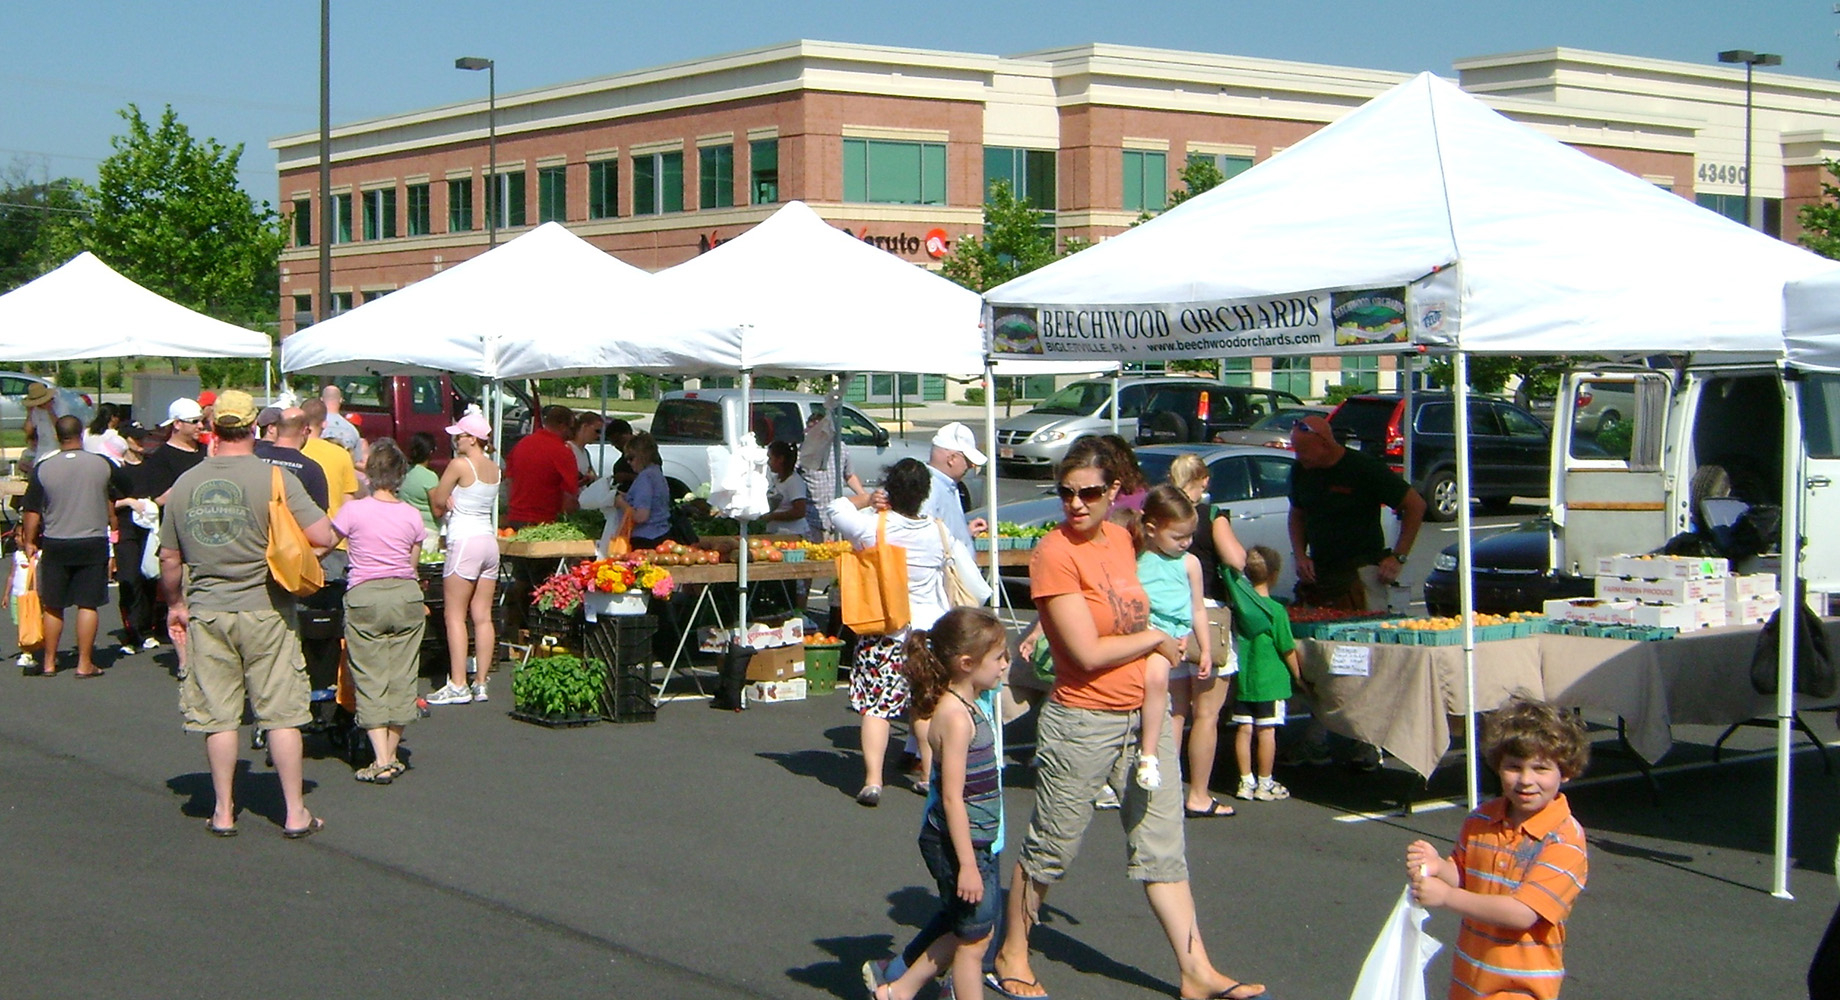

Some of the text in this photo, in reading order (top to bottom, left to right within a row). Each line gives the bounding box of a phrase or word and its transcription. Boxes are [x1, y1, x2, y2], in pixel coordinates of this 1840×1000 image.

[1698, 163, 1747, 185] 43490
[843, 226, 920, 255] aruto
[1043, 309, 1170, 339] BEECHWOOD
[1180, 296, 1319, 335] ORCHARDS
[1112, 343, 1128, 353] PA
[1147, 333, 1320, 352] www.beechwoodorchards.com
[189, 506, 246, 517] COLUMBIA
[1643, 588, 1674, 596] PRODUCE
